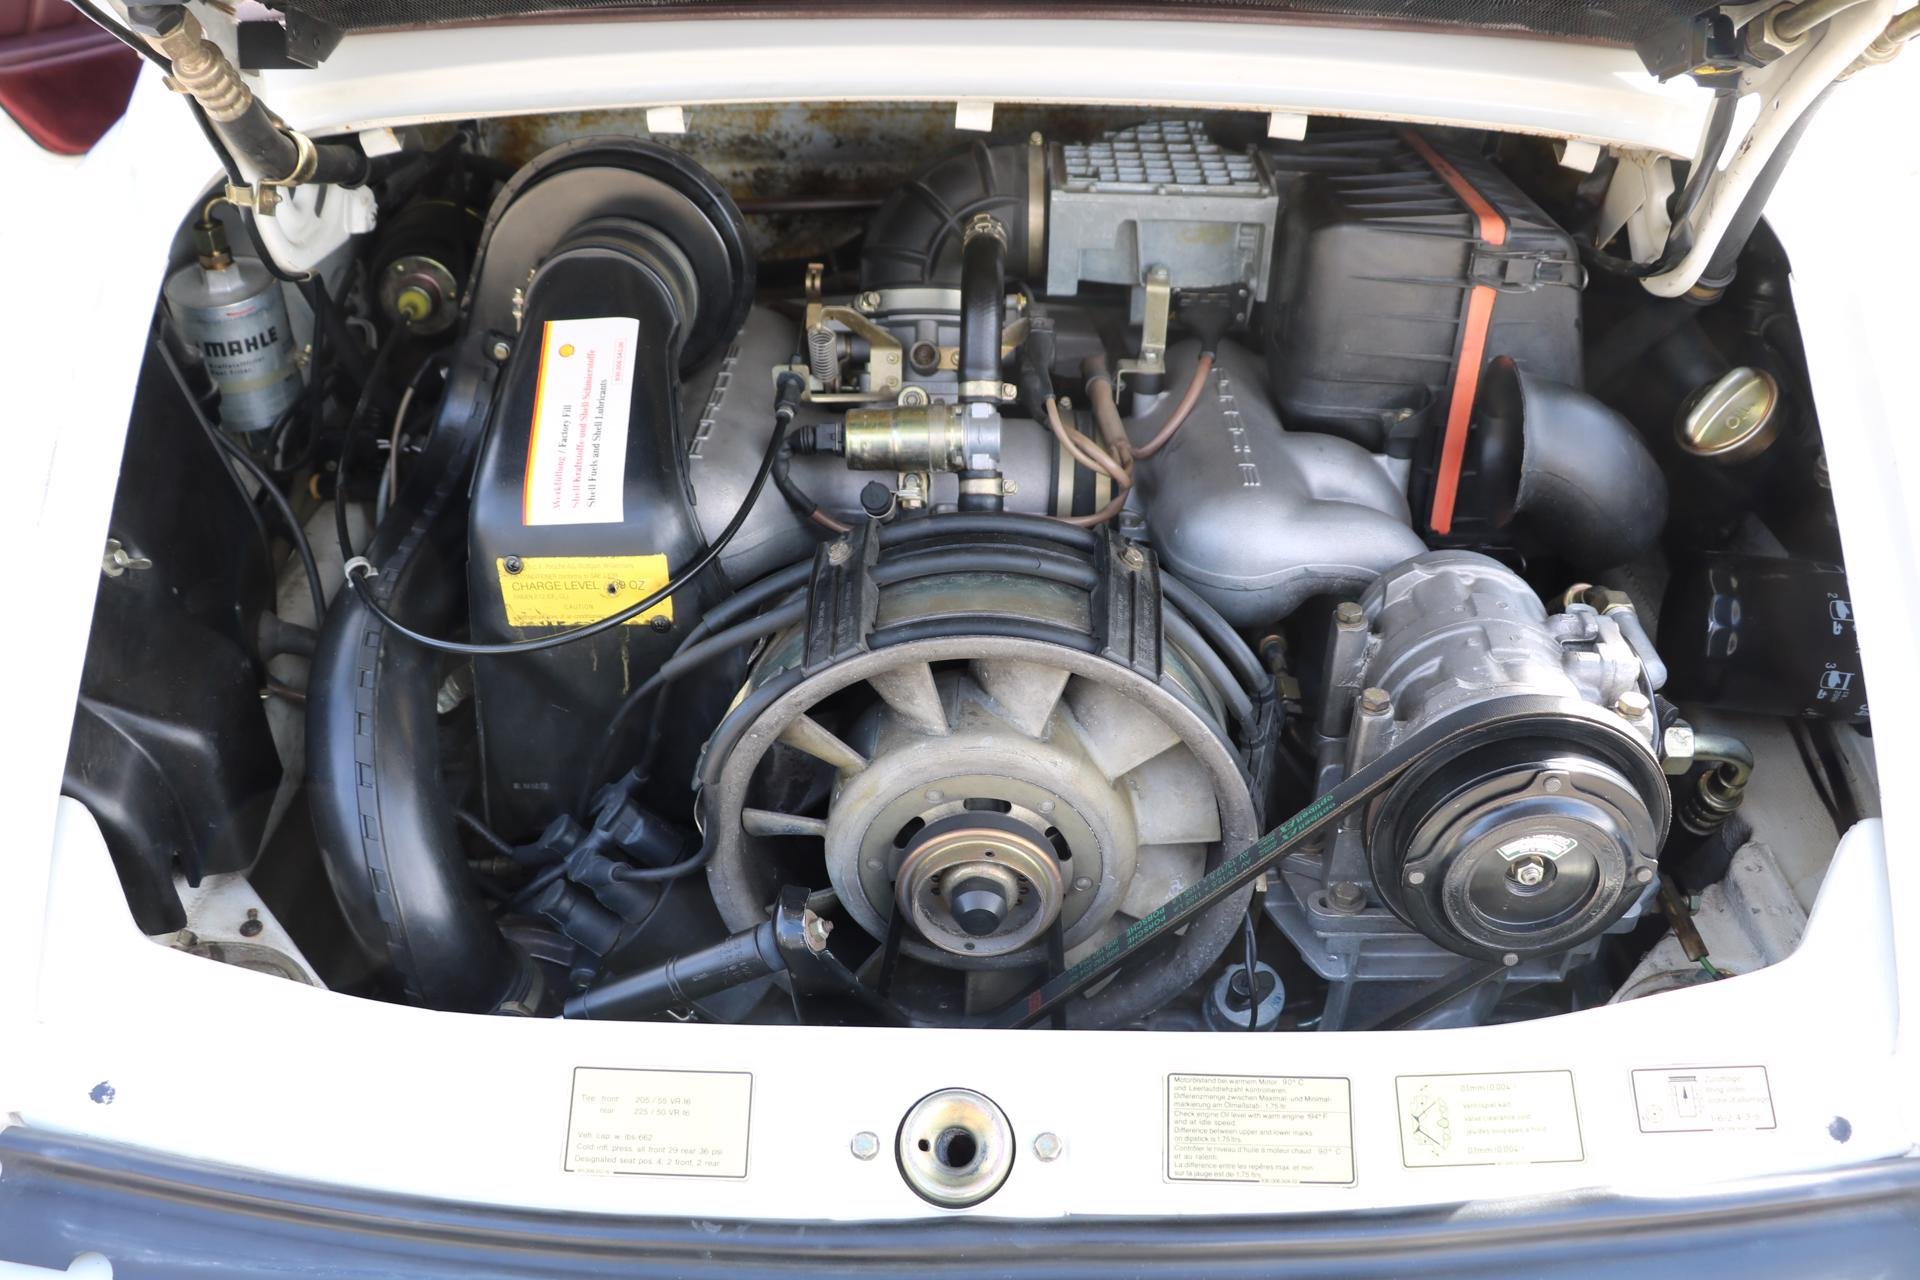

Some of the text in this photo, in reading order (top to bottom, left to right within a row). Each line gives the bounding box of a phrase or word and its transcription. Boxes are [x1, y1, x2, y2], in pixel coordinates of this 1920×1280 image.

[204, 326, 278, 357] MAHLE
[561, 404, 572, 418] Fill
[558, 420, 572, 448] Factory
[571, 349, 596, 508] Shell Kraftstoffe und Shell Schmierstoffe
[587, 379, 608, 508] Shell Fuels and Shell Lubricants
[512, 581, 560, 591] CHARGE
[564, 580, 599, 591] LEVEL
[629, 580, 646, 591] OZ
[1126, 908, 1164, 937] PORSCHE
[1127, 915, 1166, 945] PORSCHE
[574, 1155, 616, 1165] Designated
[577, 1143, 594, 1151] Cold
